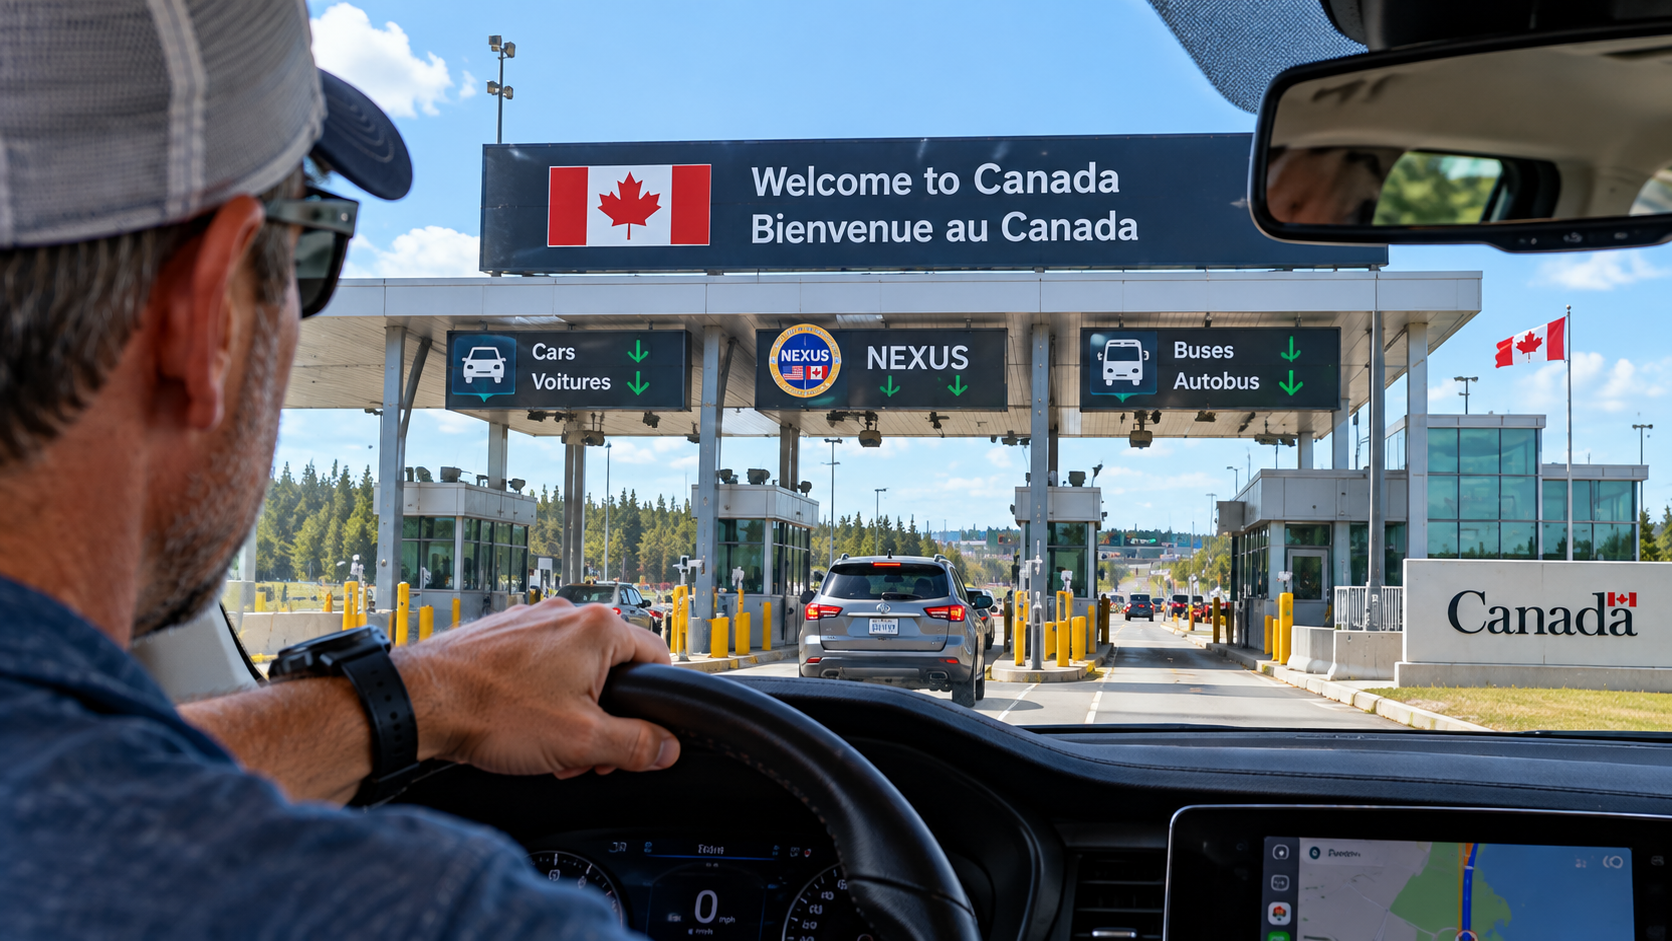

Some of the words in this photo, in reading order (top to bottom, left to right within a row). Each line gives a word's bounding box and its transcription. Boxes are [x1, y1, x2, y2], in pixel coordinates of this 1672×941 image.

[751, 165, 913, 197] Welcome
[923, 166, 960, 195] to
[975, 161, 1120, 195] Canada
[751, 212, 934, 244] Bienvenue
[945, 219, 988, 243] au
[1001, 210, 1139, 242] Canada
[531, 342, 576, 361] Cars
[781, 349, 829, 362] NEXUS
[866, 344, 970, 371] NEXUS
[1173, 341, 1234, 360] Buses
[531, 371, 612, 391] Voitures
[1173, 371, 1260, 390] Autobus
[1447, 589, 1639, 637] Canada
[695, 889, 718, 923] 0
[719, 916, 735, 924] mph
